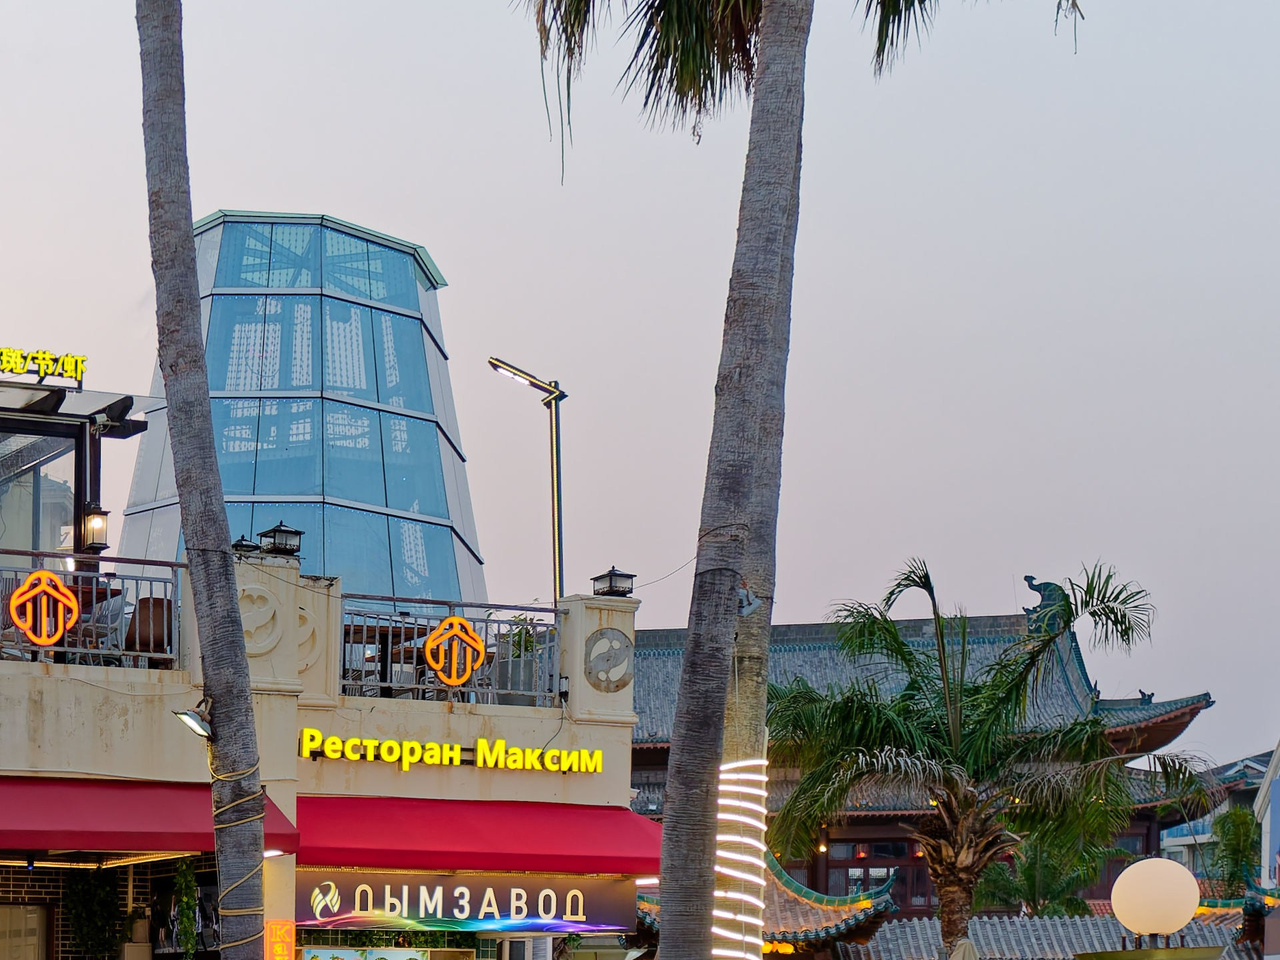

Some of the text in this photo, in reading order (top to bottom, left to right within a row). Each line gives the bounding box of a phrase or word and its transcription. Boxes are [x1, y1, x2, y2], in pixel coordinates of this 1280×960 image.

[301, 727, 603, 774] Ресторан Максим
[351, 883, 587, 922] ДЫМЗАВОД
